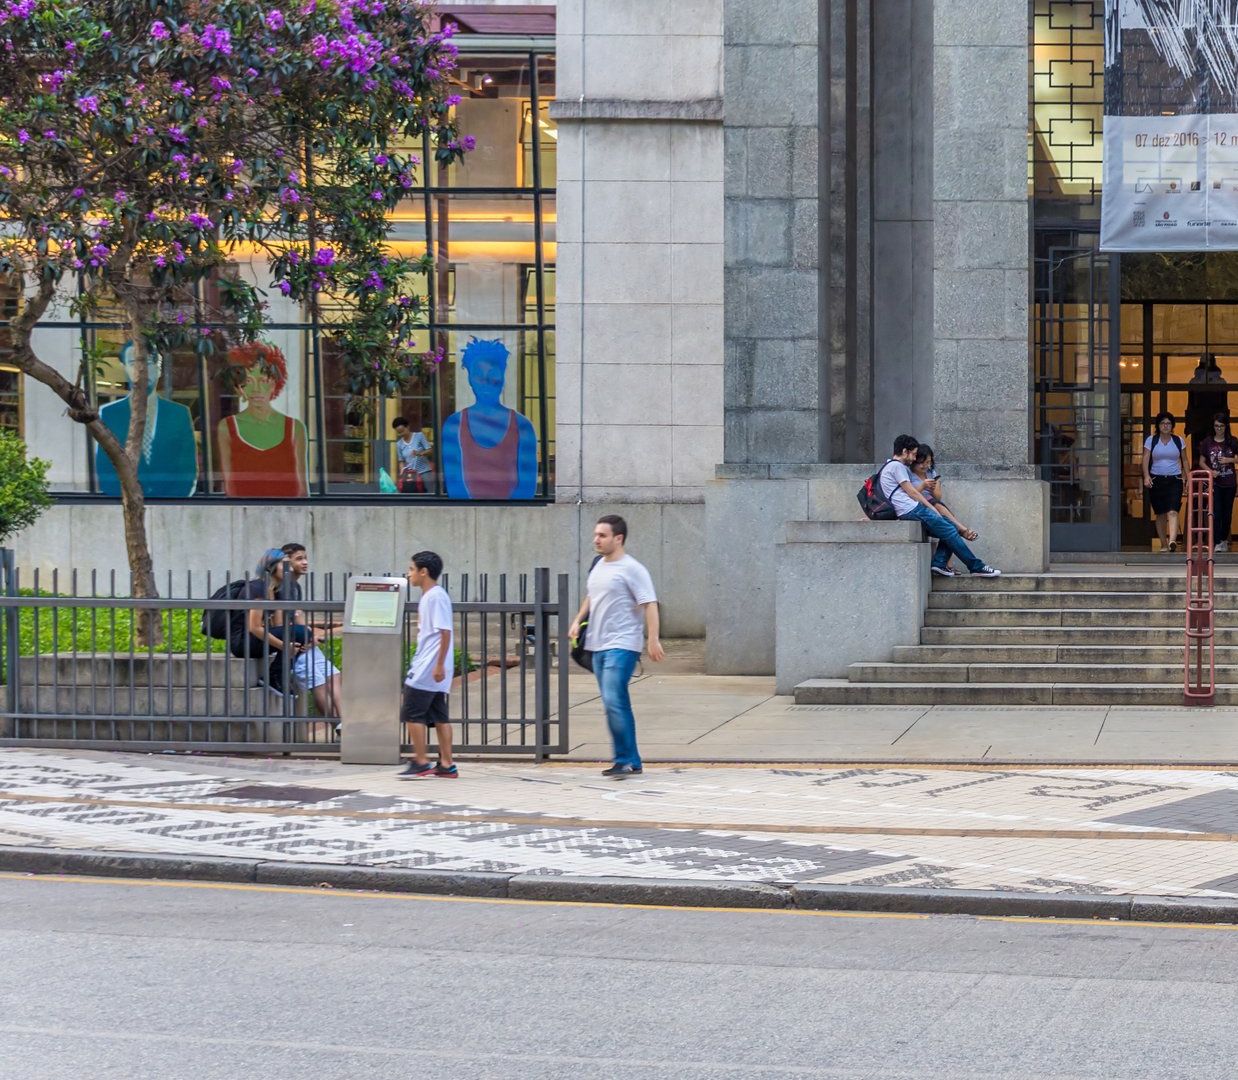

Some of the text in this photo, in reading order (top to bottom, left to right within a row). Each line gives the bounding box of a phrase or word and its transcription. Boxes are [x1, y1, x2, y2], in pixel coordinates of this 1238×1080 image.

[1135, 134, 1148, 147] 07
[1152, 132, 1170, 147] dez
[1173, 133, 1199, 147] 2016
[1214, 132, 1226, 146] 12
